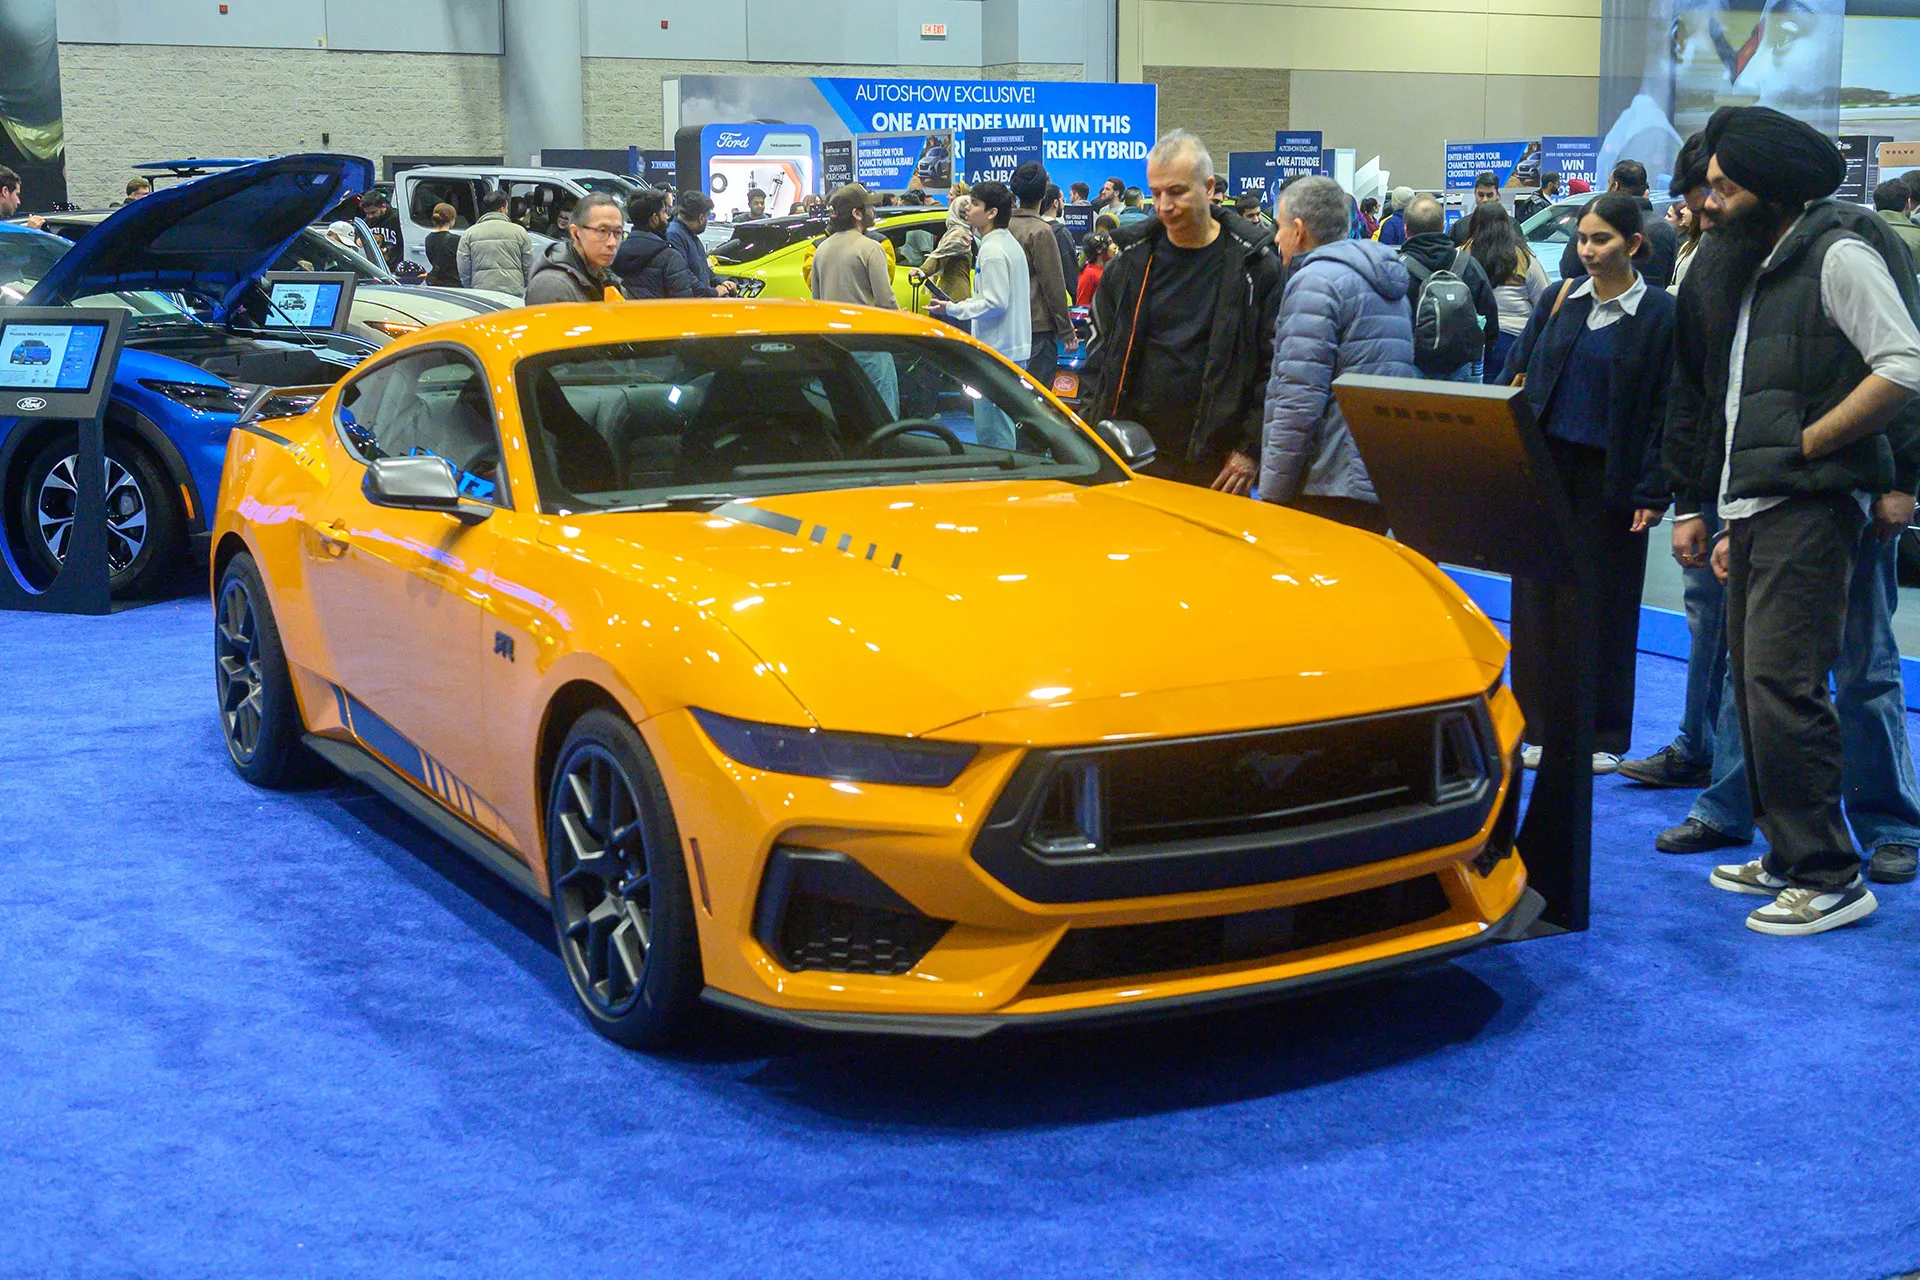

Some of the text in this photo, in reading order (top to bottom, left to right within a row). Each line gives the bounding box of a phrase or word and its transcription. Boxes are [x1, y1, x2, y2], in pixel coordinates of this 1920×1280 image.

[856, 84, 1036, 103] AUTOSHOW EXCLUSIVE!
[872, 112, 1131, 133] ONE ATTENDEE WILL WIN THIS
[716, 132, 750, 148] Ford
[990, 155, 1017, 167] WIN
[1486, 152, 1500, 160] YOUR
[1277, 157, 1290, 166] ONE
[1290, 157, 1320, 166] ATTENDEE
[1491, 160, 1512, 168] SUBARU
[1562, 160, 1584, 170] WIN
[972, 170, 981, 183] A
[1298, 168, 1312, 177] WIN
[1241, 177, 1265, 188] TAKE
[21, 400, 42, 408] Ford
